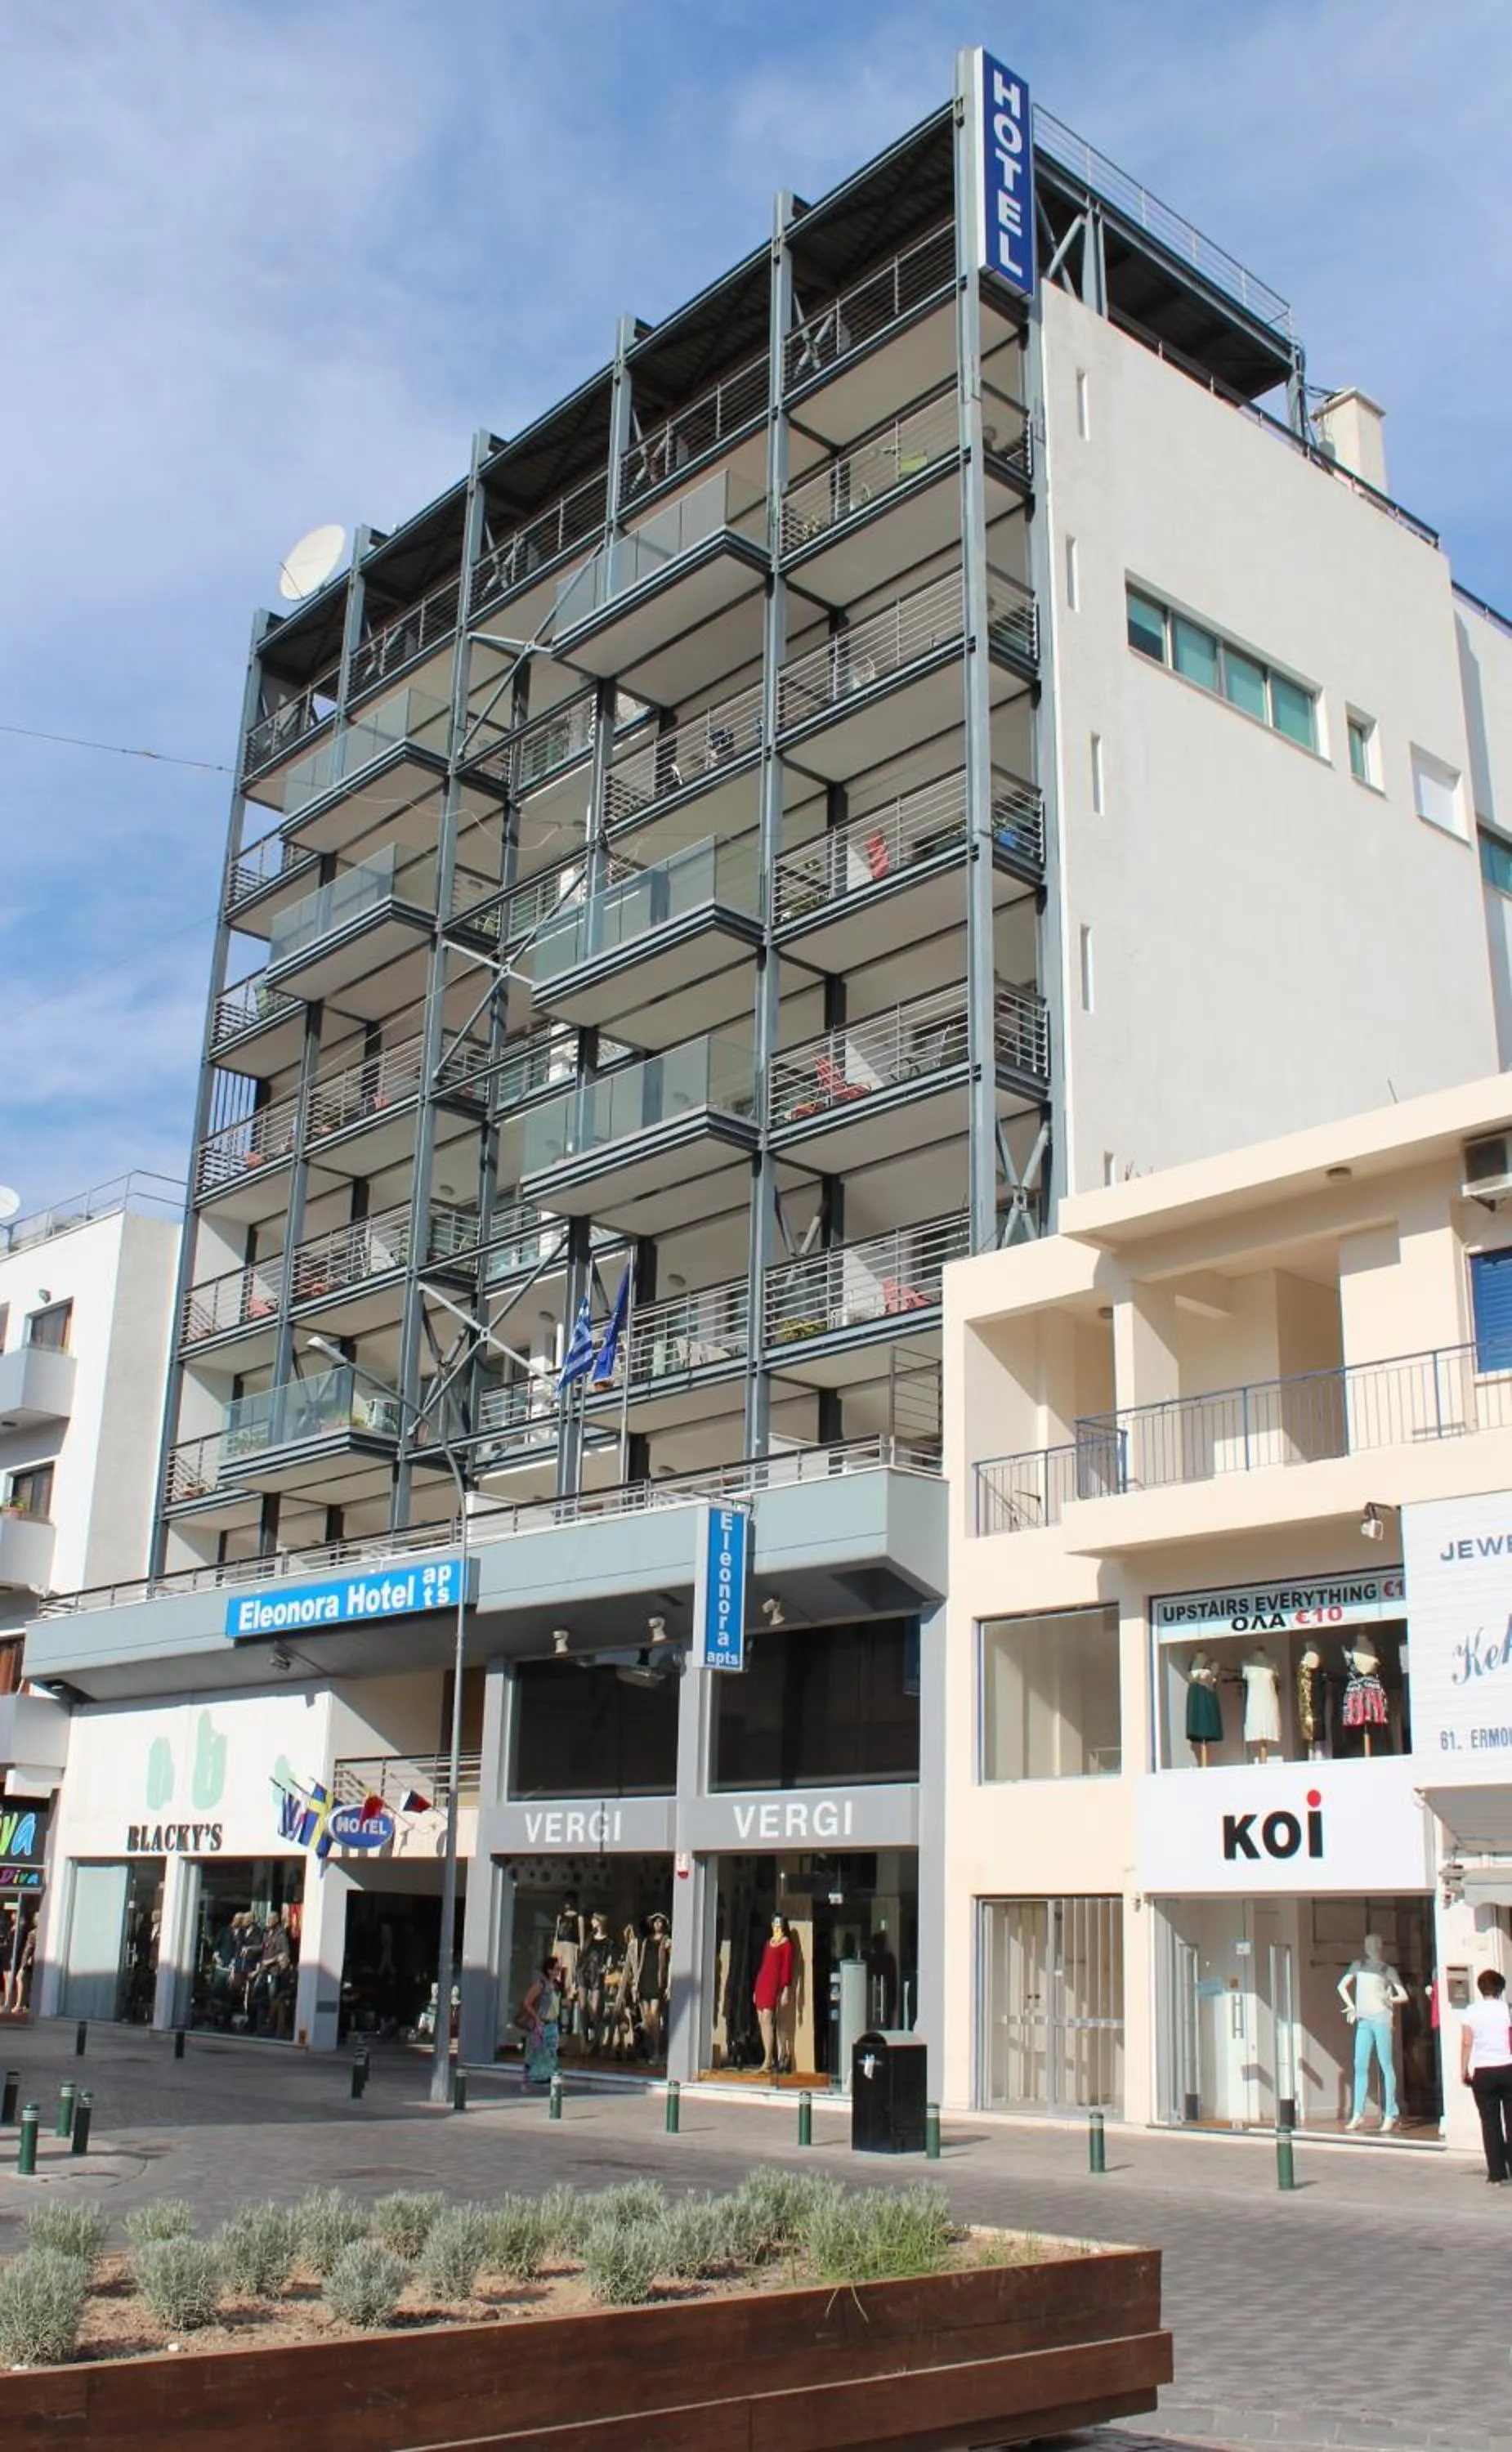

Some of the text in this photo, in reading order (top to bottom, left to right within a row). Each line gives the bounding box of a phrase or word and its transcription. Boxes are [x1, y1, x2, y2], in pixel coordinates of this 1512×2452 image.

[993, 69, 1022, 277] HOTEL
[717, 1511, 733, 1647] Eleonora
[238, 1575, 414, 1631] Eleonora Hotel
[1163, 1598, 1250, 1623] UPSTAIRS
[1255, 1583, 1377, 1613] EVERYTHING
[1232, 1606, 1343, 1631] ΟΛΑ €10
[706, 1650, 739, 1667] apts
[0, 1812, 36, 1856] va
[127, 1823, 223, 1851] BLACKY'S
[336, 1816, 387, 1836] HOTEL
[525, 1810, 621, 1843] VERGI
[733, 1801, 852, 1839] VERGI
